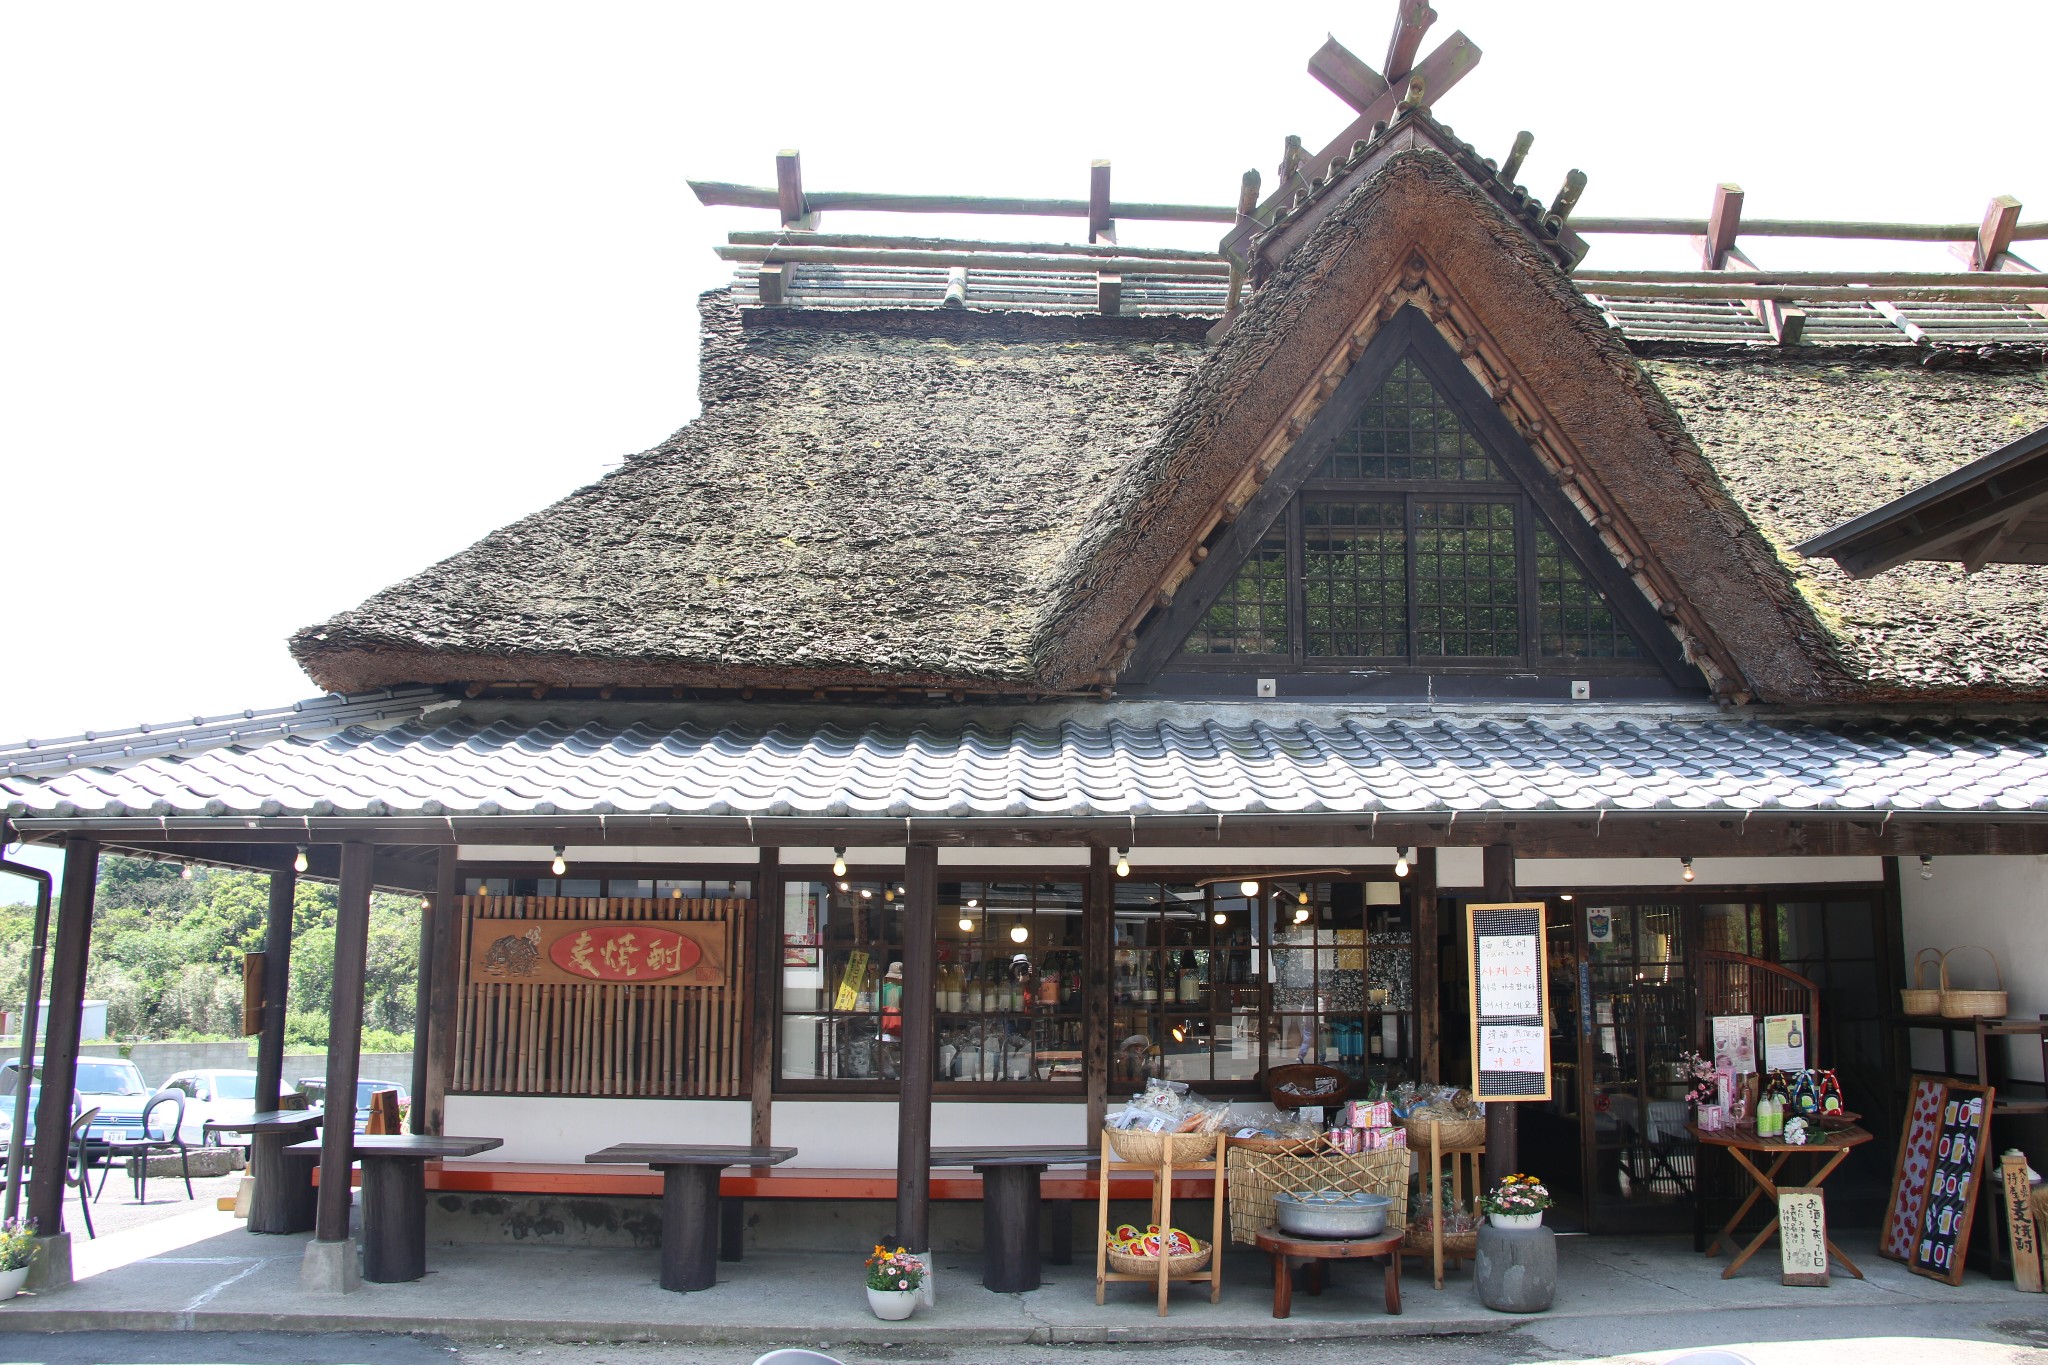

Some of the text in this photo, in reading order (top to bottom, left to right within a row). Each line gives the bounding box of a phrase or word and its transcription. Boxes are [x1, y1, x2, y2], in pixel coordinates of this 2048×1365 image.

[569, 931, 683, 977] 麦焼酎
[1481, 965, 1532, 977] 사케 소주
[1481, 983, 1497, 992] 시음
[2006, 1172, 2019, 1198] 特産
[2018, 1167, 2028, 1197] 大分県
[2011, 1199, 2033, 1254] 麦焼酎
